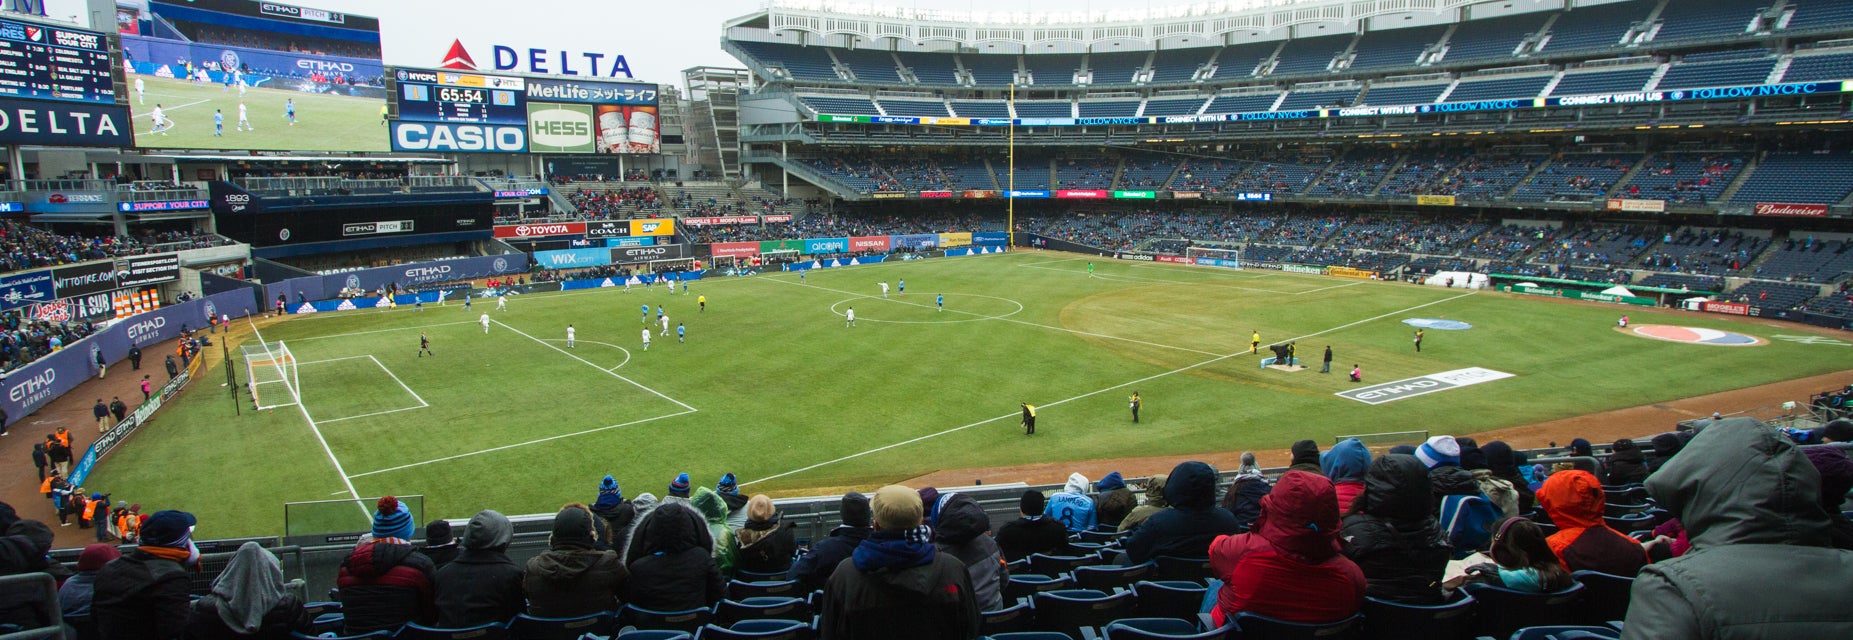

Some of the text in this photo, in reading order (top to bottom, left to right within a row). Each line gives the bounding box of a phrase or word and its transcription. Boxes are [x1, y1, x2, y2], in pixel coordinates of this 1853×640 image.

[262, 3, 326, 19] ETIHAD PITCH
[0, 27, 26, 40] RES
[55, 30, 99, 43] SUPPORT
[56, 38, 99, 50] YOUR CITY
[296, 59, 355, 72] ETIHAD
[494, 45, 635, 79] DELTA
[409, 72, 437, 83] NYCFC
[411, 86, 509, 105] 1 65:54 0
[527, 83, 589, 99] MetLife
[593, 88, 657, 102] メットライフ
[1691, 83, 1817, 99] FOLLOW NYCFC
[1435, 99, 1519, 112] FOLLOW NYCFC
[1559, 92, 1663, 106] CONNECT WITH US
[1242, 111, 1308, 120] FOLLOW NYCFC
[1339, 105, 1416, 116] CONNECT WITH US
[1112, 117, 1139, 125] NYCFC
[1165, 116, 1198, 124] CONNECT
[1198, 115, 1216, 123] WITH
[534, 120, 588, 136] HESS
[396, 123, 525, 152] CASIO
[68, 194, 103, 202] TERRACE
[133, 199, 207, 210] SUPPORT YOUR CITY
[225, 194, 250, 202] 1893
[1755, 203, 1826, 216] Budweiser
[345, 224, 399, 234] ETIHAD PITCH
[531, 225, 568, 234] TOYOTA
[590, 228, 627, 236] COACH
[642, 223, 660, 232] SAP
[855, 240, 884, 248] NISSAN
[625, 247, 667, 256] ETIHAD
[131, 257, 178, 268] STEINERSPORTS.COM
[145, 266, 168, 274] SECTION
[405, 265, 451, 278] ETIHAD
[1283, 265, 1321, 275] Heineken
[55, 270, 115, 290] NITTOTIRE.COM
[414, 273, 444, 282] AIRWAYS
[1524, 287, 1613, 301] Heineken Heineken
[36, 299, 69, 319] Jersey
[79, 293, 110, 318] A SUB
[1706, 303, 1744, 311] MODELL'S
[127, 316, 167, 339] ETIHAD
[135, 329, 160, 344] AIRWAYS
[9, 367, 57, 403] ETIHAD
[1354, 380, 1440, 400] ETIHAD
[22, 387, 52, 409] AIRWAYS
[133, 396, 162, 427] Heineken
[116, 416, 135, 436] ETIHAD
[95, 431, 116, 453] ETIHAD
[1058, 496, 1084, 507] LAMPARD
[1059, 506, 1073, 529] 8
